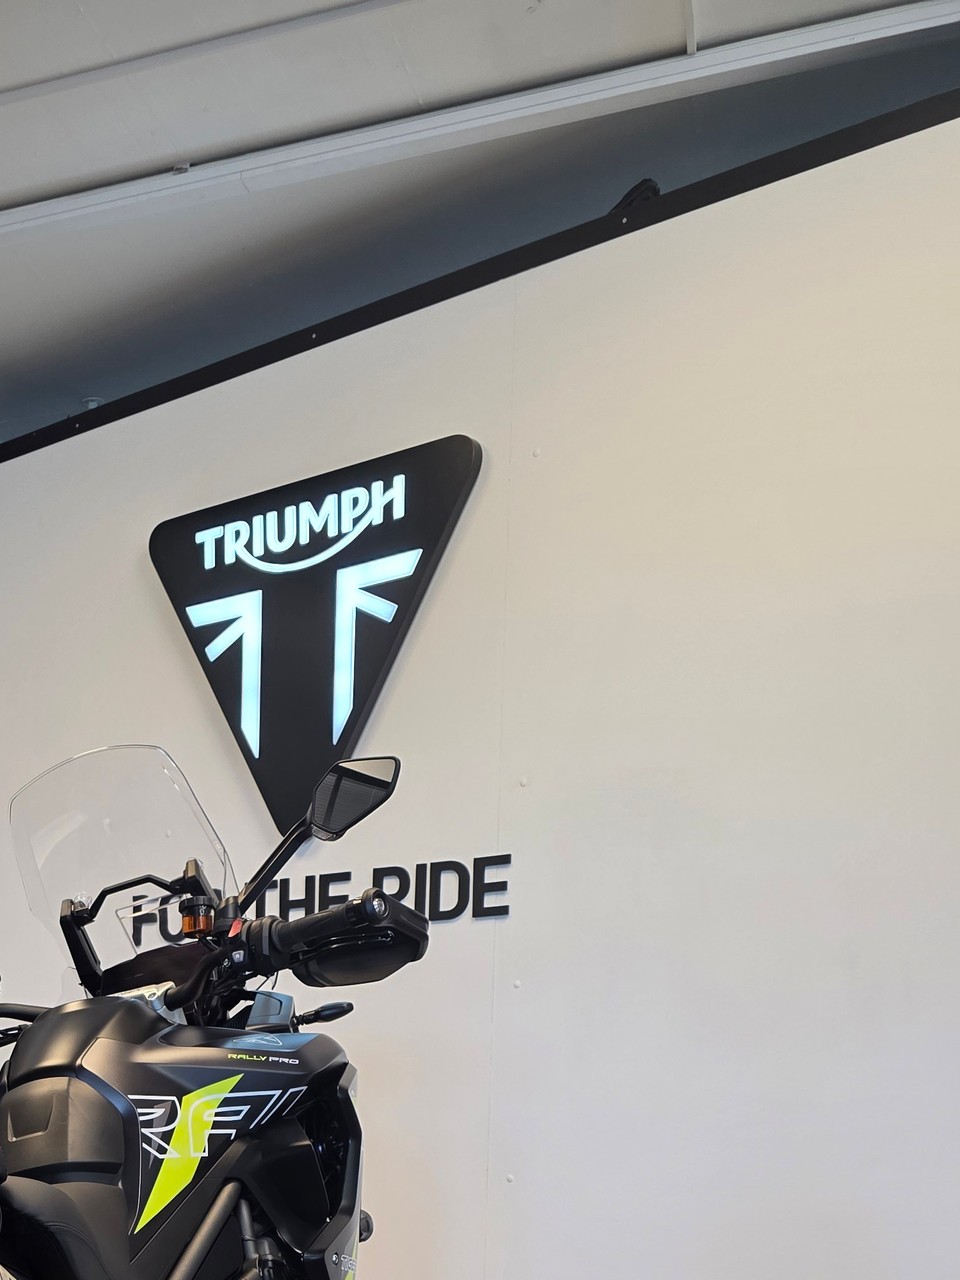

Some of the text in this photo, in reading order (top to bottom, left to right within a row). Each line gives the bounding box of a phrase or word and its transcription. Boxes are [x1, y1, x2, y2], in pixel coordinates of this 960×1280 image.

[195, 474, 406, 573] TRIUMPH
[373, 854, 512, 922] RIDE
[227, 1053, 300, 1065] RALLY PRO
